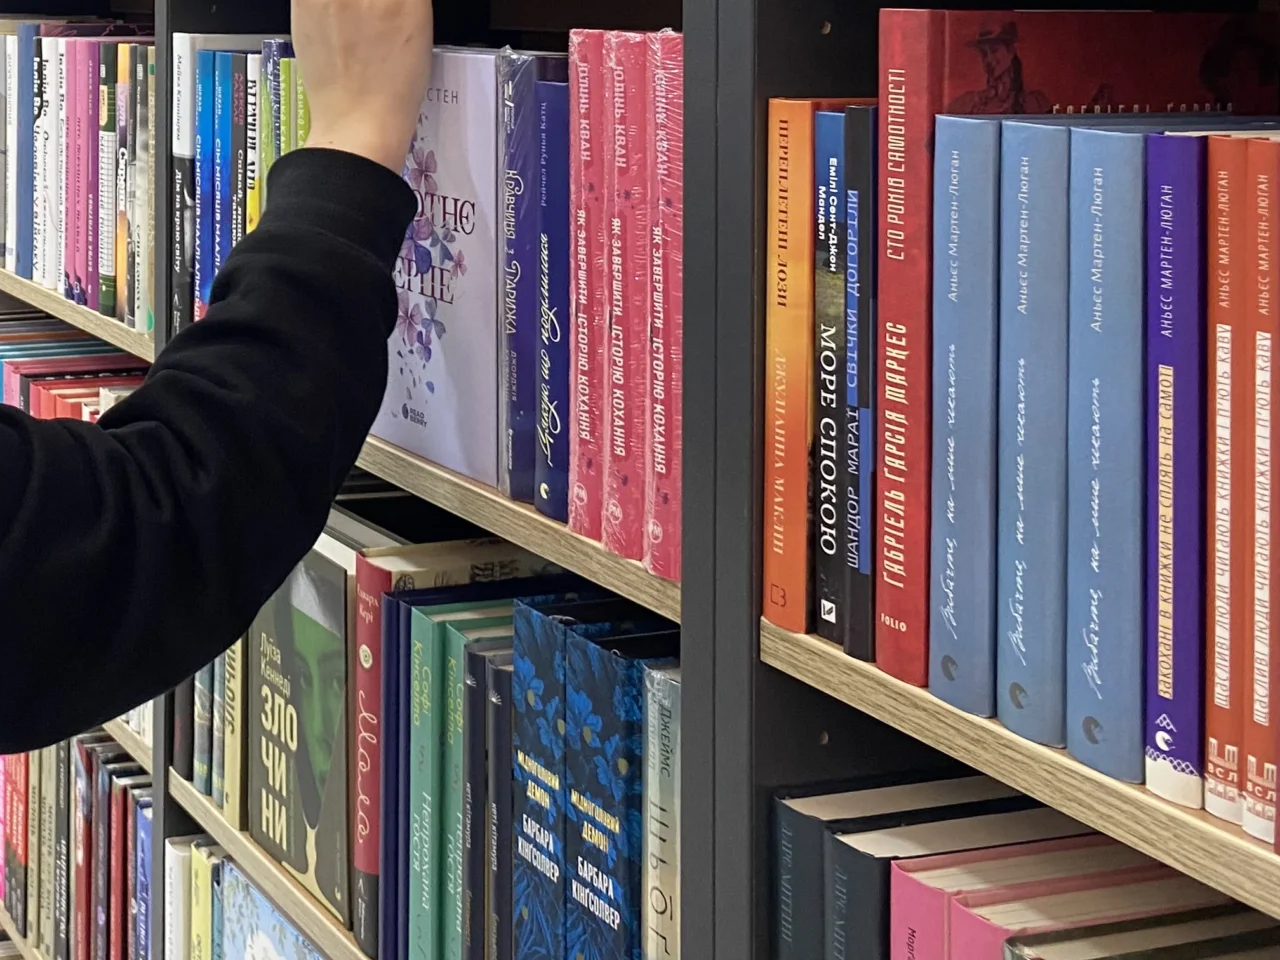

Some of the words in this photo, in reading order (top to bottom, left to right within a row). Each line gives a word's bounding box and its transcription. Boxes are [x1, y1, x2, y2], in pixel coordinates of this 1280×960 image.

[887, 68, 906, 173] САМОТНОСТІ
[576, 209, 587, 227] ЯК
[887, 177, 905, 224] РОКІВ
[948, 149, 961, 256] Мартен-Люган
[1217, 168, 1231, 266] МАРТЕН-ЛЮГАН
[828, 195, 838, 273] Сент-Джон
[847, 189, 860, 298] ДОГОРІЛИ
[886, 229, 905, 261] СТО
[1160, 184, 1175, 290] МАРТЕН-ЛЮГАН
[577, 229, 588, 305] ЗАВЕРШИТИ
[777, 253, 788, 308] ЛОЗИ
[946, 258, 959, 303] Аньєс
[1218, 269, 1230, 309] АНЬЄС
[577, 312, 589, 370] ІСТОРІЮ
[847, 308, 857, 389] СВІЧКИ
[1161, 294, 1174, 338] АНЬЄС
[820, 322, 836, 409] МОРЕ
[578, 374, 590, 441] КОХАННЯ
[1160, 424, 1171, 448] на
[847, 407, 859, 475] МАРАЇ
[1215, 434, 1231, 502] книжки
[820, 417, 836, 556] СПОКОЮ
[1160, 452, 1173, 510] сплять
[847, 486, 860, 570] ШАНДОР
[1161, 513, 1171, 537] не
[1215, 505, 1231, 578] читають
[1160, 539, 1172, 605] книжки
[260, 632, 281, 664] Луїза
[880, 612, 908, 632] FOLIO
[261, 656, 291, 697] Кеннеді
[412, 640, 422, 727] Кінселла
[419, 666, 432, 716] Софі
[261, 684, 298, 752] ЗЛО
[660, 703, 672, 778] ДЖЕЙМС
[261, 736, 287, 799] ЧИ
[526, 779, 550, 810] ДЕМОН
[261, 787, 287, 852] НИ
[419, 791, 432, 910] Непрохана
[522, 813, 554, 854] БАРБАРА
[581, 821, 609, 853] ДЕМОН
[577, 856, 613, 900] БАРБАРА
